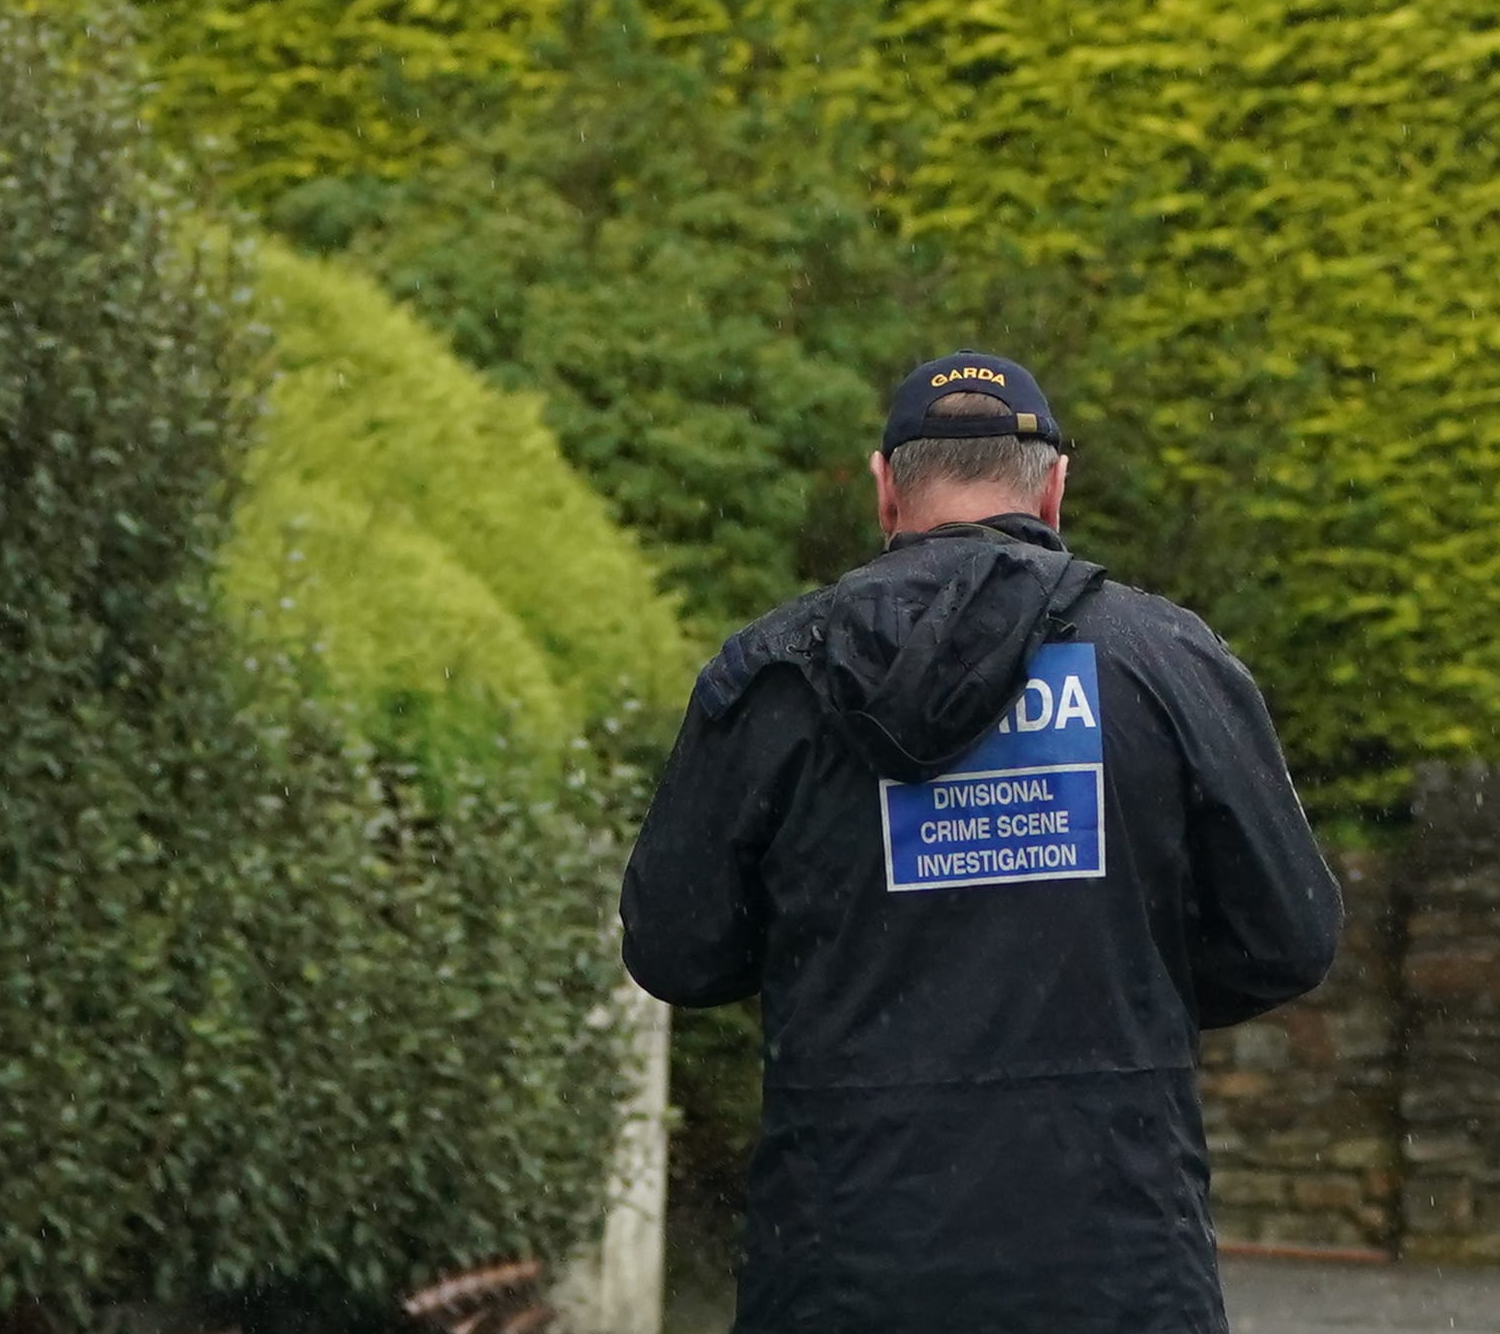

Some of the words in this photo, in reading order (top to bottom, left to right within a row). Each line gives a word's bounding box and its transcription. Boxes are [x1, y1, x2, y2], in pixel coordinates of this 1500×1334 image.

[931, 367, 1005, 387] GARDA
[933, 779, 1053, 809] DIVISIONAL
[921, 817, 991, 844] CRIME
[997, 811, 1069, 838] SCENE
[917, 844, 1077, 878] INVESTIGATION
